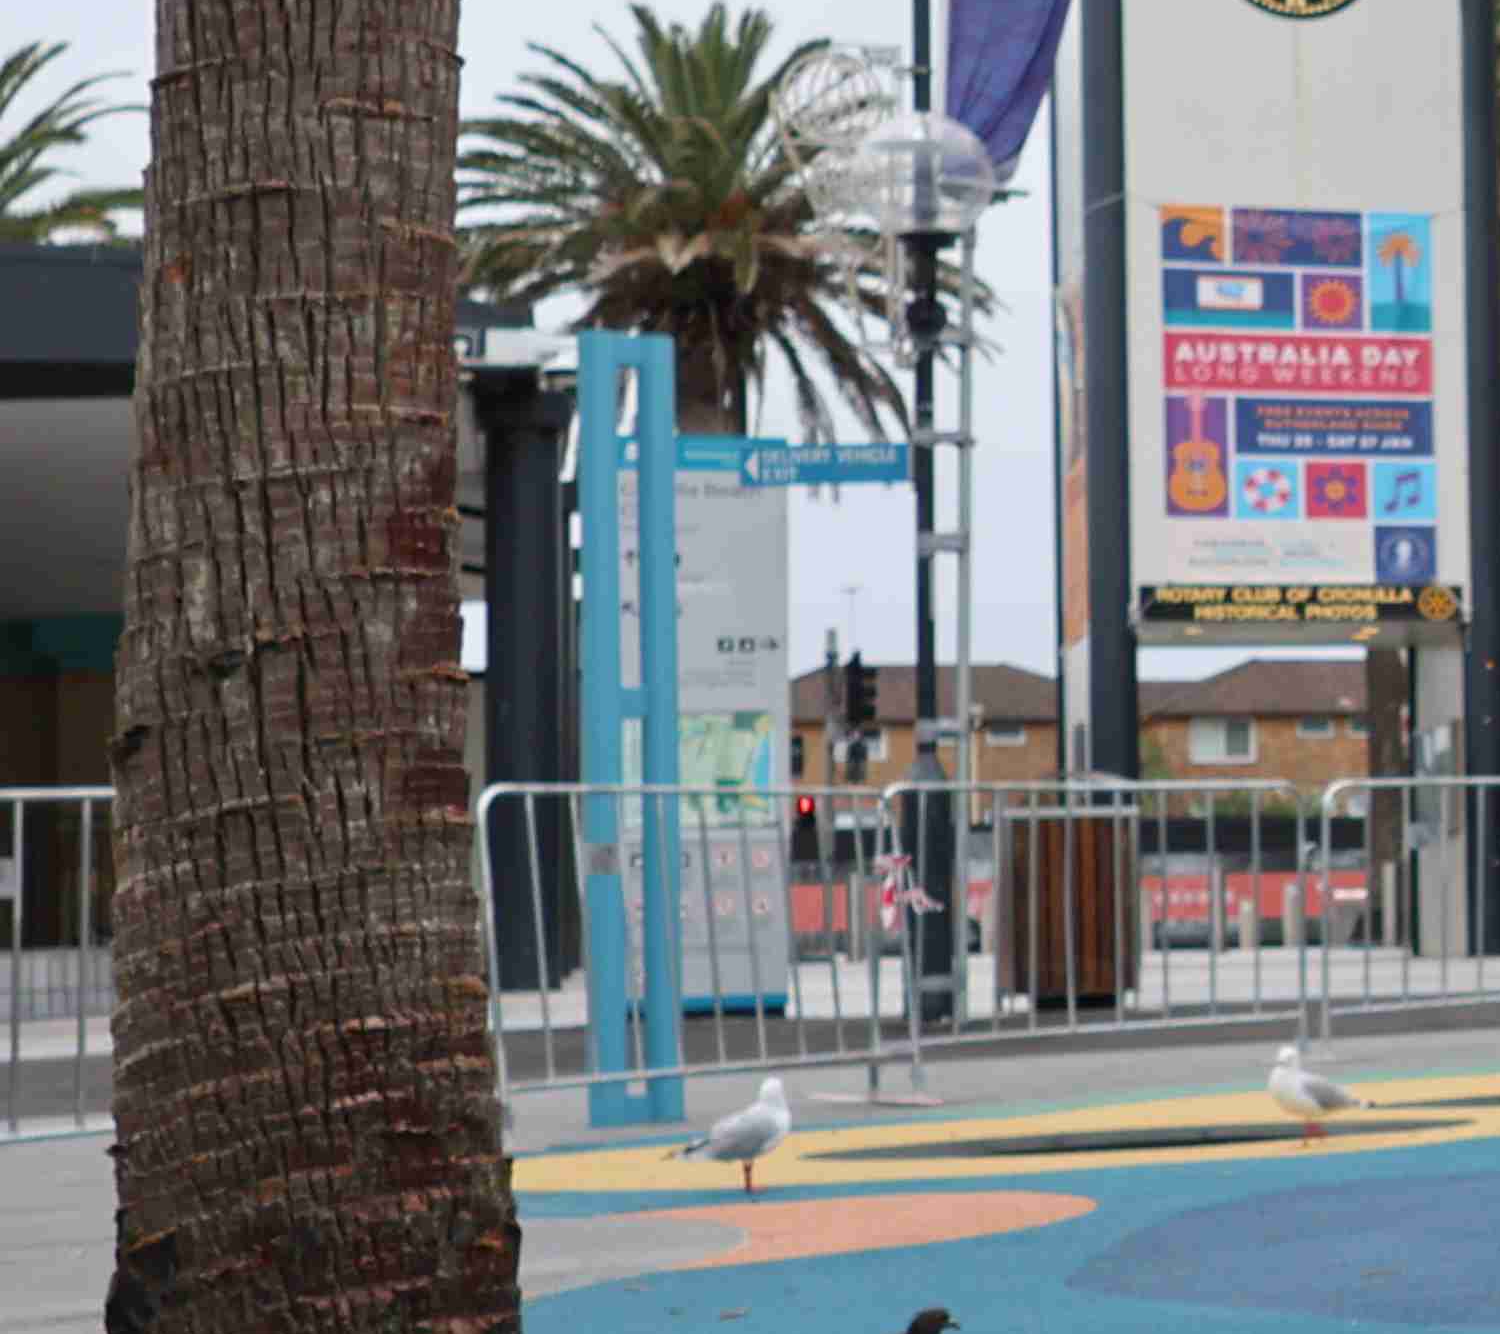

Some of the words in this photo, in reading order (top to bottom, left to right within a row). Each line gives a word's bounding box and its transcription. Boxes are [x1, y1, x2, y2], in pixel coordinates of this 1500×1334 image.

[1174, 341, 1351, 365] AUSTRALIA
[1360, 346, 1420, 366] DAY
[1174, 364, 1260, 384] LONG
[1272, 365, 1422, 387] WEEKEND
[1156, 586, 1226, 603] ROTARY
[1231, 586, 1282, 603] CLUB
[1285, 587, 1312, 603] OF
[1316, 587, 1413, 604] CRONULLA
[1193, 603, 1300, 621] HISTORICAL
[1304, 603, 1379, 621] PHOTOS
